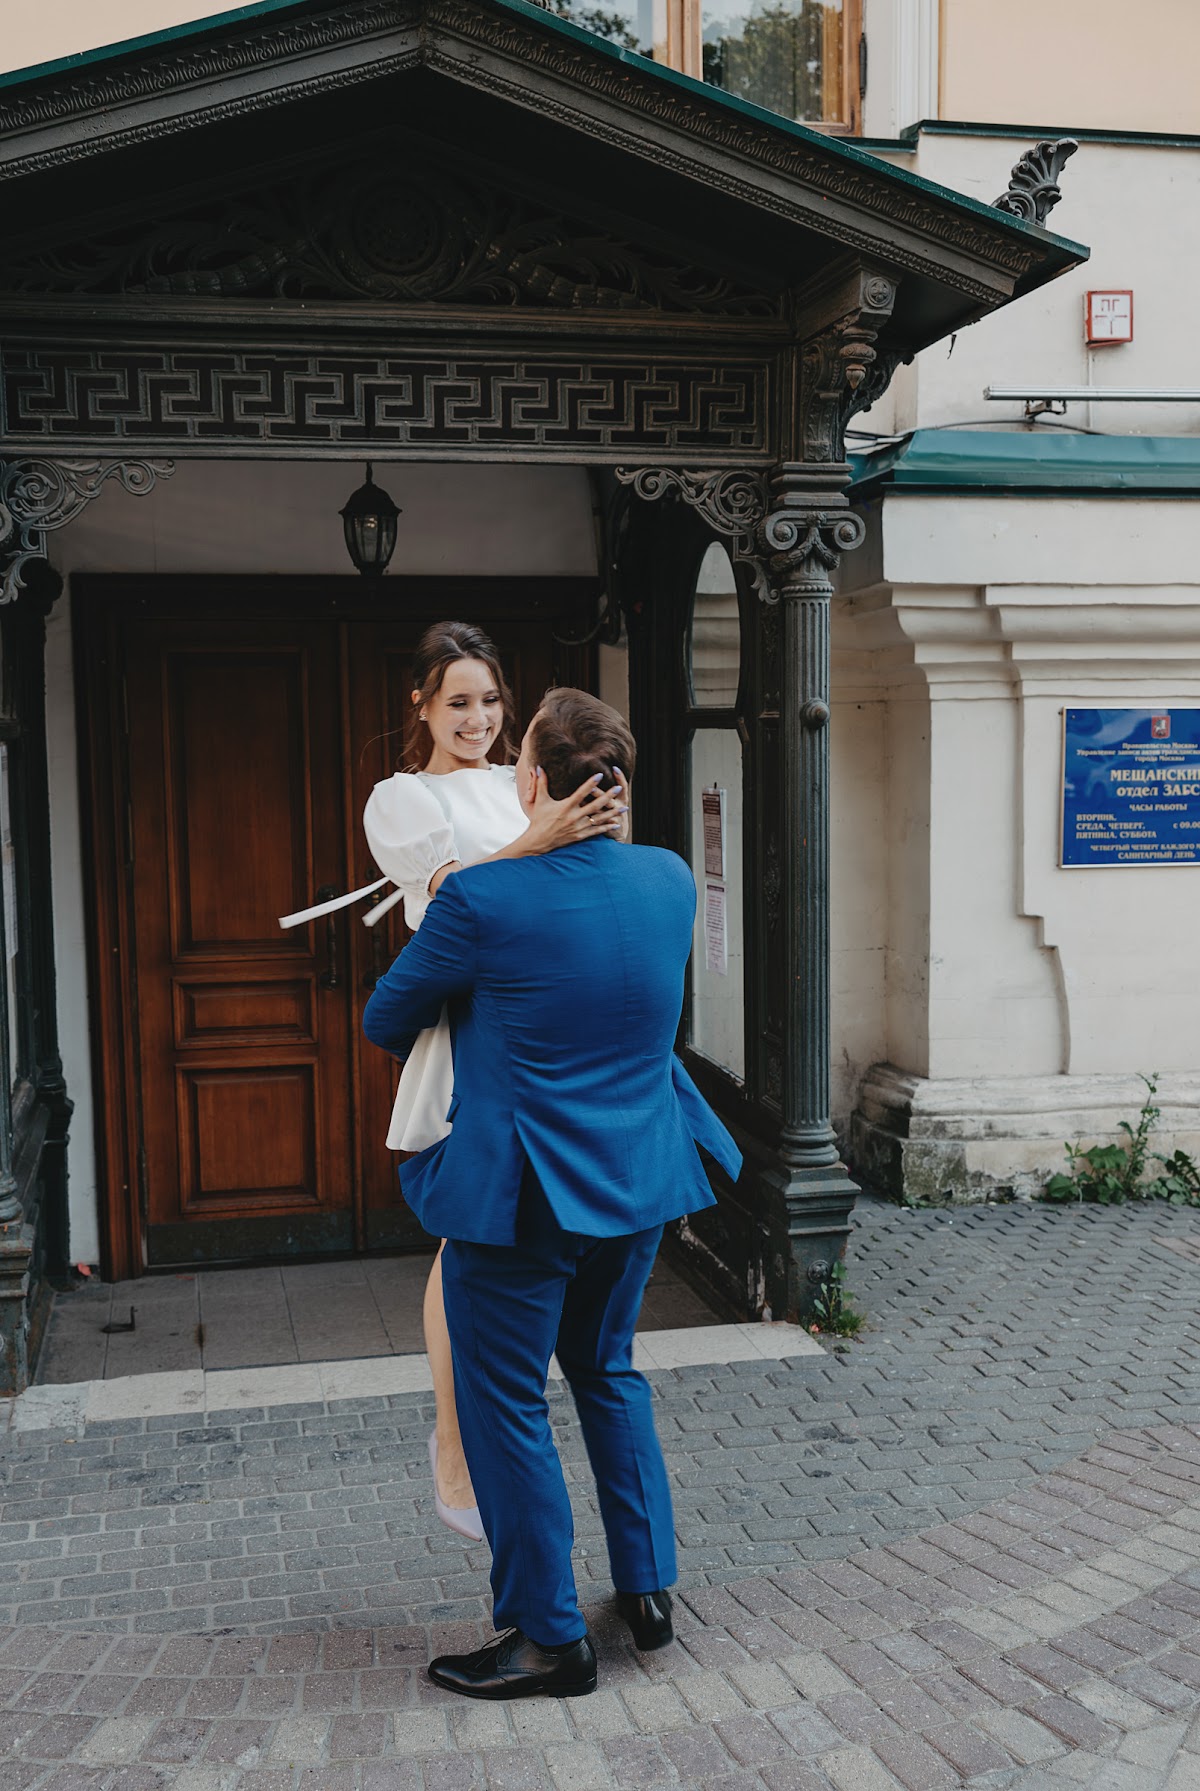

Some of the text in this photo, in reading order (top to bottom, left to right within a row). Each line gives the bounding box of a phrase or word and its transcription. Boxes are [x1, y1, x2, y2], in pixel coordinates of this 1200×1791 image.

[1117, 786, 1158, 797] отдел
[1129, 803, 1188, 812] ЧАСЫ РАБОТЫ
[1118, 851, 1196, 859] САНИТАРНЫЙ ДЕНЬ
